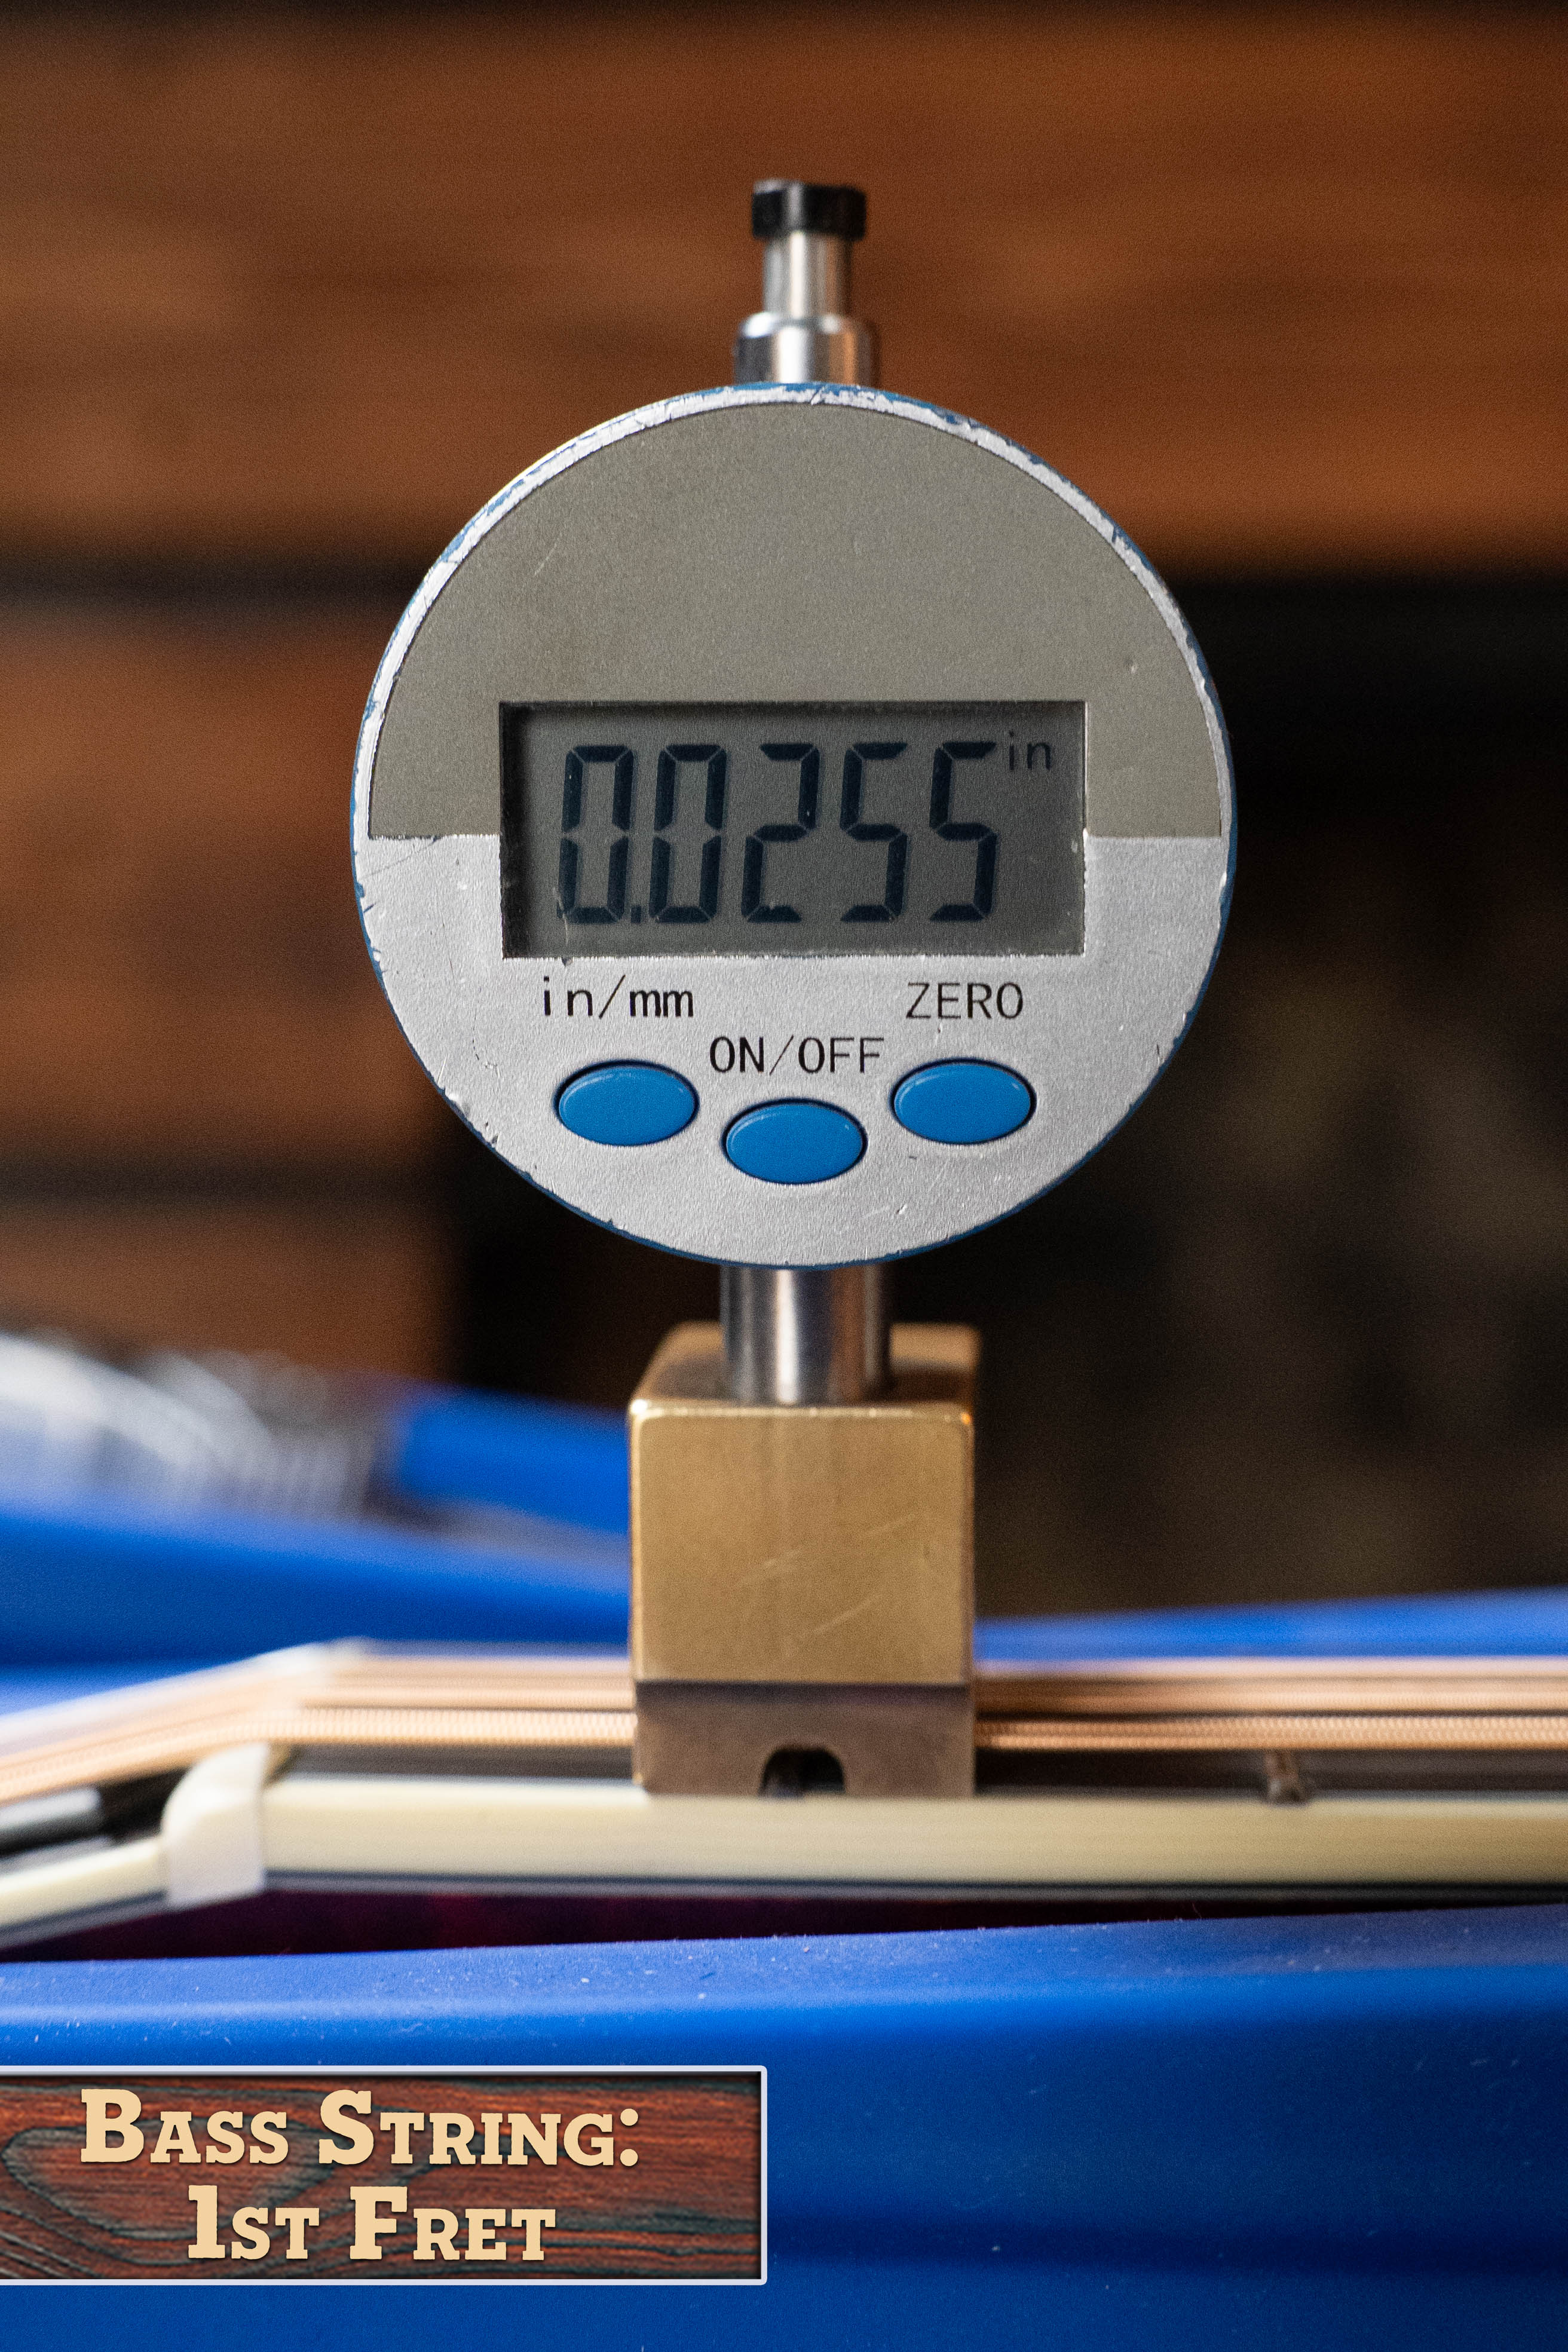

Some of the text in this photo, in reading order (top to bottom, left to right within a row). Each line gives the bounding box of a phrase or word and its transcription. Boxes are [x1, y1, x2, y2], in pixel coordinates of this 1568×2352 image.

[559, 732, 1054, 924] 0.0255 in
[543, 975, 694, 1019] in/mm
[905, 982, 1024, 1019] ZERO
[709, 1036, 885, 1074] ON/OFF
